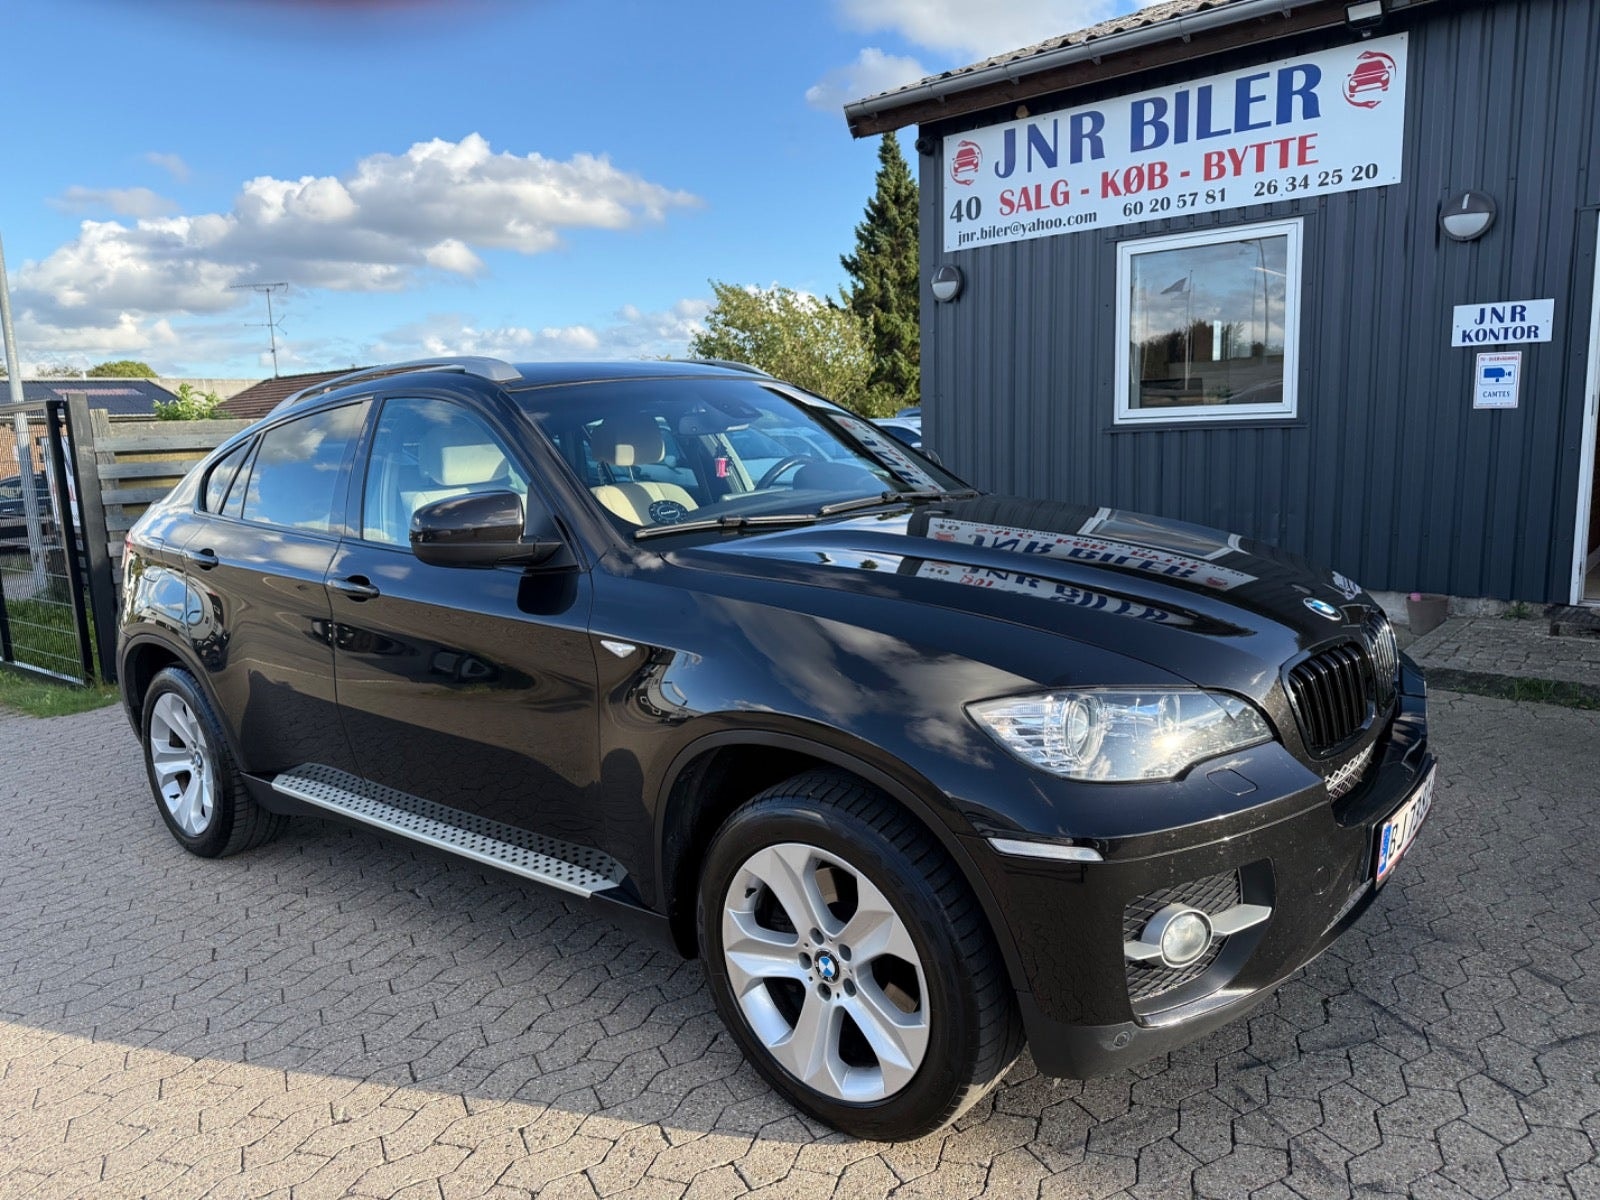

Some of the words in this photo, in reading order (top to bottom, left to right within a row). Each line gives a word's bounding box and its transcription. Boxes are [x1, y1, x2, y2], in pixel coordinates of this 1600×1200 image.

[994, 110, 1105, 178] JNR
[1129, 63, 1322, 152] BILER
[999, 179, 1070, 216] SALG
[1101, 161, 1169, 199] KØB
[1203, 133, 1319, 182] BYTTE
[1254, 180, 1278, 197] 26
[1284, 173, 1309, 192] 34
[1317, 169, 1343, 187] 25
[1351, 162, 1379, 182] 20
[950, 196, 982, 223] 40
[1122, 200, 1144, 217] 60
[1149, 196, 1171, 214] 20
[1176, 191, 1199, 209] 57
[1204, 187, 1226, 205] 81
[957, 210, 1098, 246] jnr.biler@yahoo.com
[1474, 304, 1527, 326] JNR
[1461, 324, 1540, 343] KONTOR
